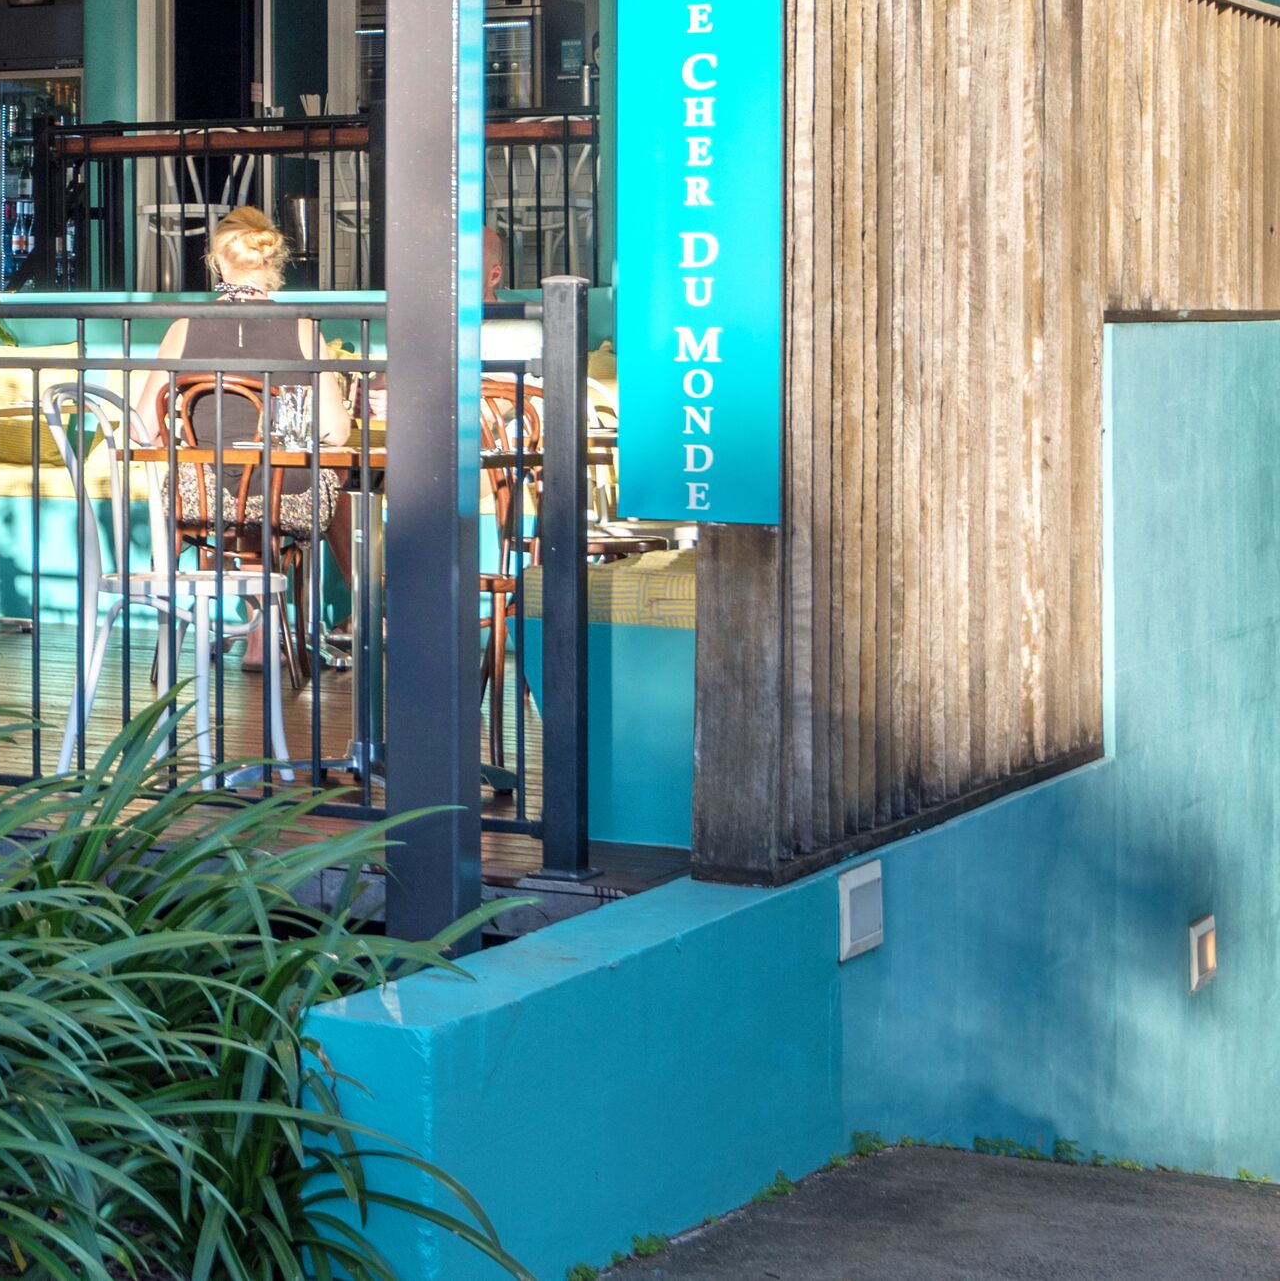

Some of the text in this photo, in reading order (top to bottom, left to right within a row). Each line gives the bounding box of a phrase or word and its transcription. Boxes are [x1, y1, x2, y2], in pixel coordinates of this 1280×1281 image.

[681, 52, 718, 206] CHER
[678, 231, 720, 308] DU
[673, 325, 724, 511] MONDE
